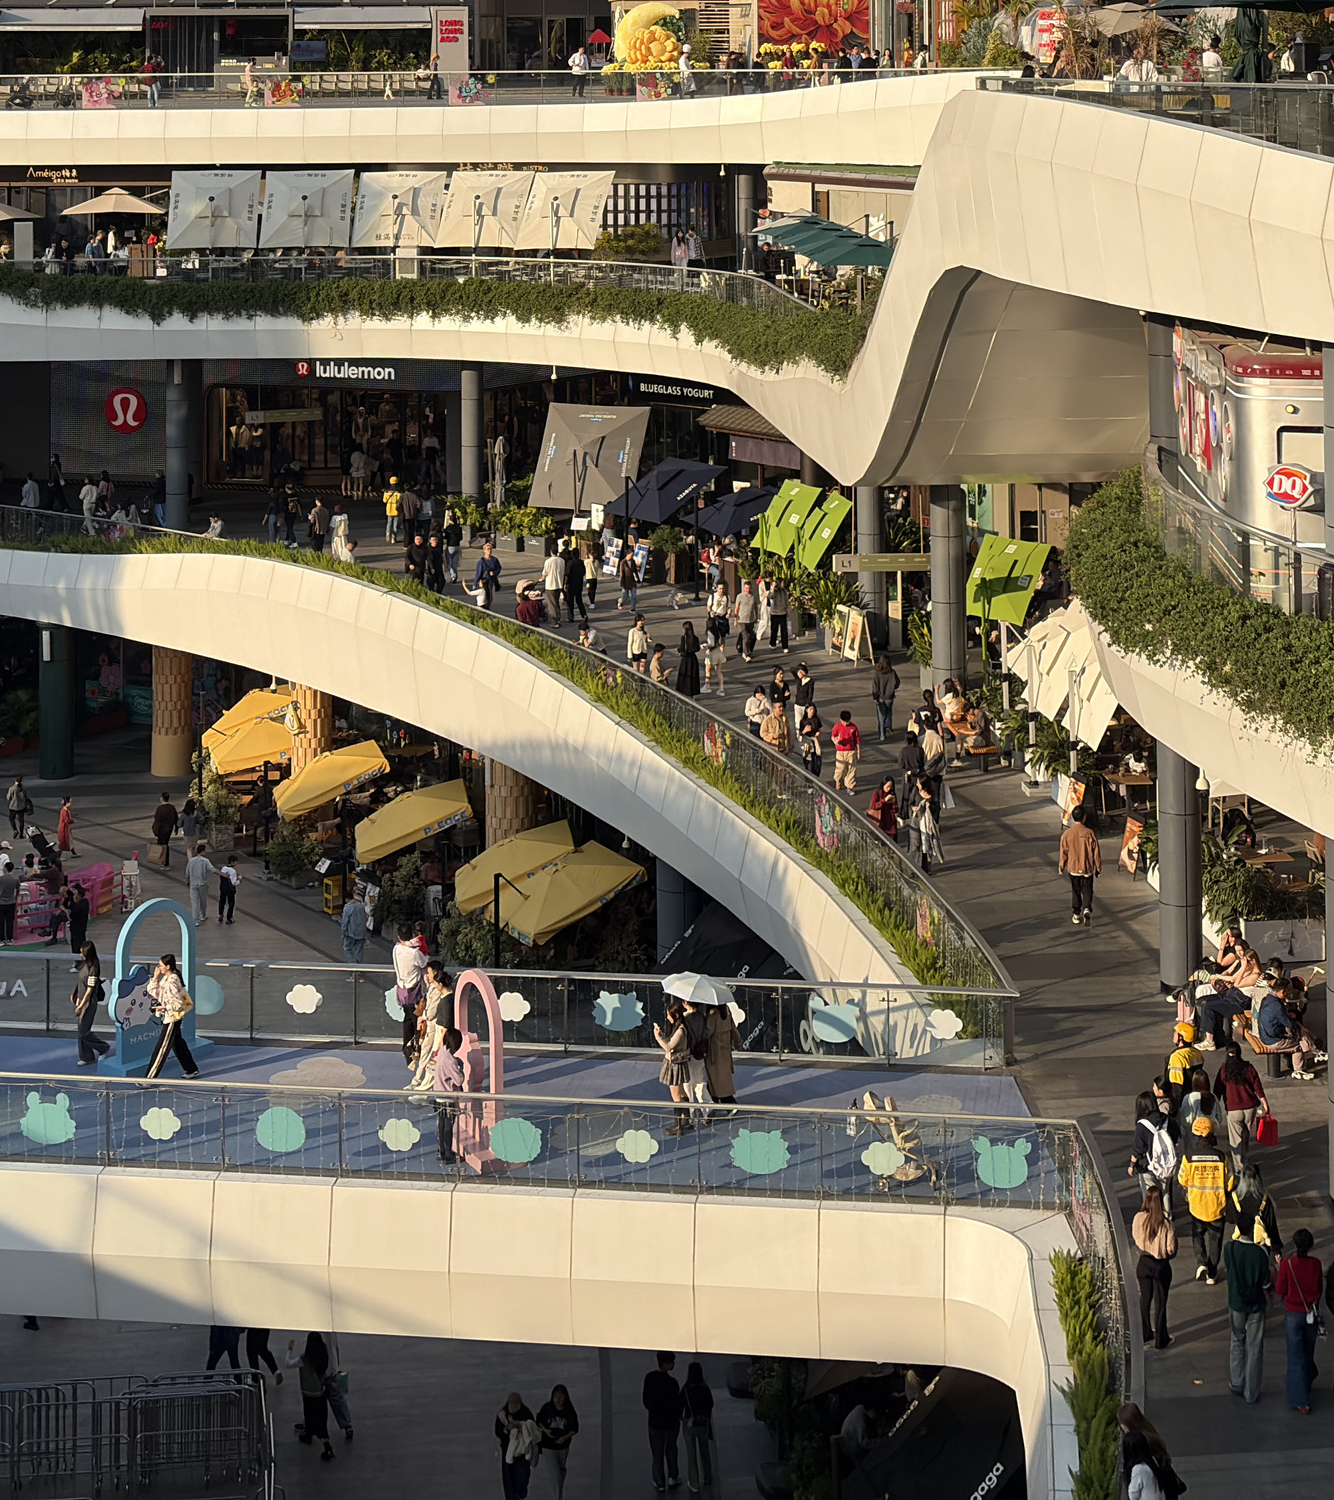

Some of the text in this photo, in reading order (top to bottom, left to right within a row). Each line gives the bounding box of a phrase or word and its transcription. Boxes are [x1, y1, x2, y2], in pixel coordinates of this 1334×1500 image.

[438, 19, 464, 27] LONG
[438, 27, 464, 35] LONG
[438, 35, 460, 43] AGO
[315, 361, 396, 380] lululemon
[640, 382, 714, 400] BLUEGLASS YOGURT
[1272, 473, 1304, 499] DQ
[841, 559, 852, 568] L1
